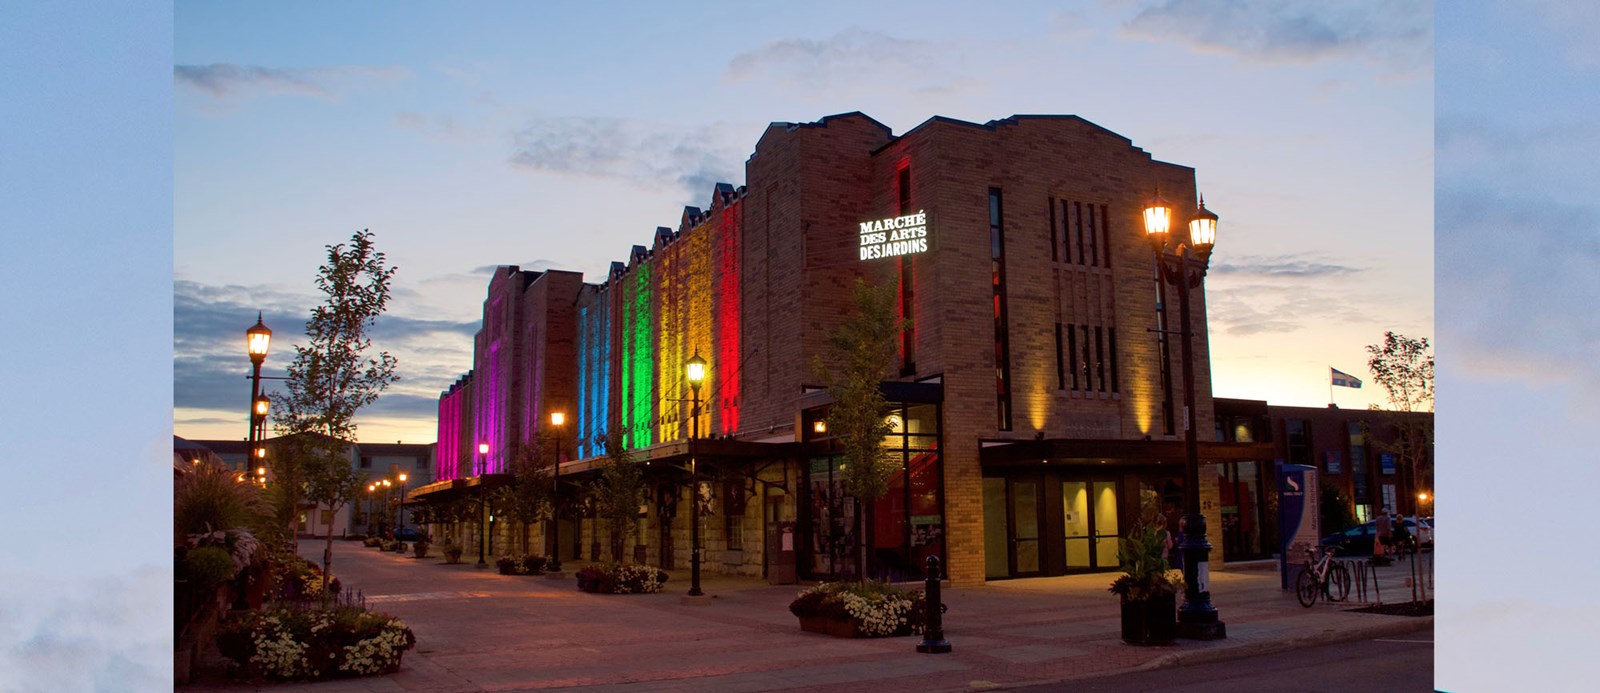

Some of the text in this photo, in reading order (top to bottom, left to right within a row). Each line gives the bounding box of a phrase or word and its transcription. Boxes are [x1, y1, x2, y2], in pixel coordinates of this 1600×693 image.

[859, 209, 926, 234] MARCHÉ
[860, 225, 927, 246] DES ARTS
[860, 238, 928, 261] DESJARDINS
